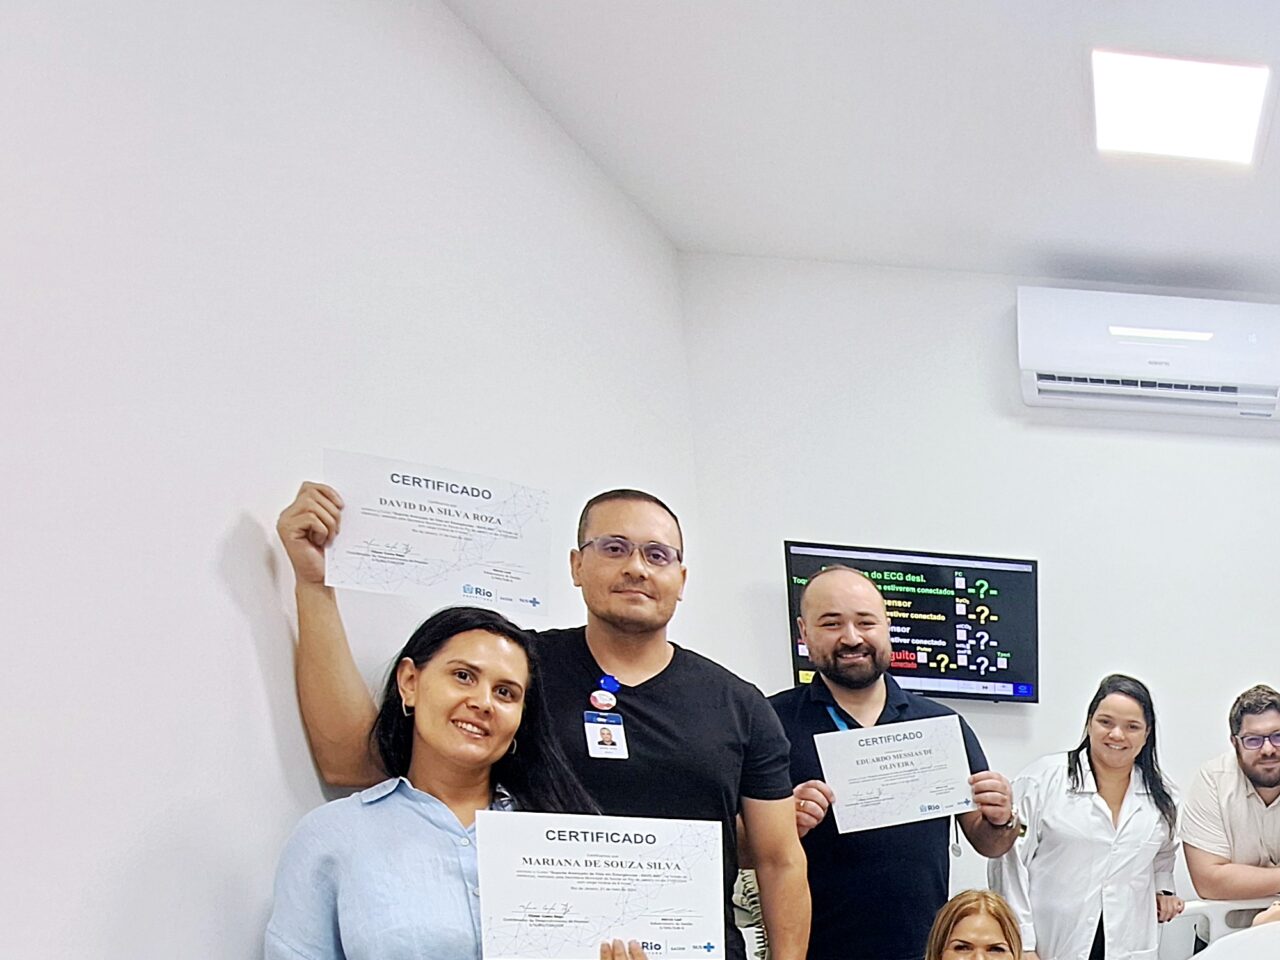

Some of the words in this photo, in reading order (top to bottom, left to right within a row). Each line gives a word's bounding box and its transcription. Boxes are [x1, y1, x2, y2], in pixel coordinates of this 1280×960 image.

[390, 473, 492, 500] CERTIFICADO
[379, 497, 416, 510] DAVID
[419, 504, 434, 514] DA
[437, 507, 469, 519] SILVA
[473, 513, 502, 525] ROZA
[793, 577, 808, 585] Toq
[884, 572, 903, 580] ECG
[475, 587, 492, 598] Rio
[890, 650, 916, 660] guito
[858, 731, 923, 747] CERTIFICADO
[856, 755, 891, 766] EDUARDO
[880, 761, 914, 770] OLIVEIRA
[546, 830, 656, 845] CERTIFICADO
[522, 857, 581, 868] MARIANA
[584, 859, 601, 868] DE
[604, 860, 644, 870] SOUZA
[646, 861, 681, 870] SILVA
[641, 941, 662, 951] Rio
